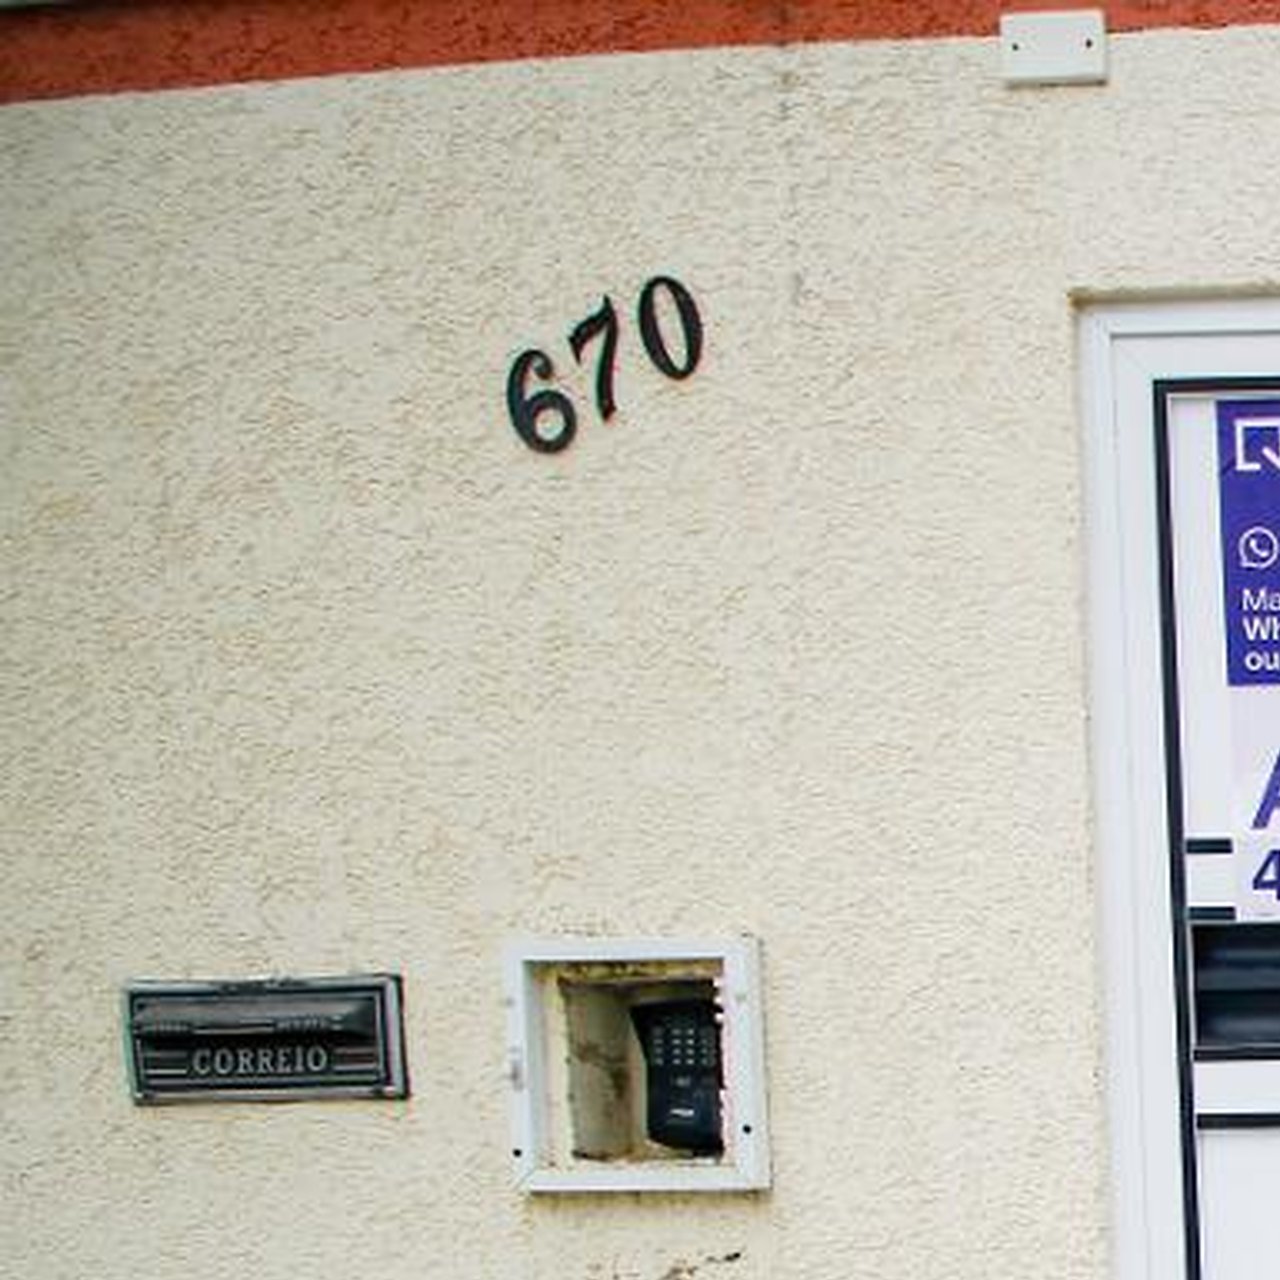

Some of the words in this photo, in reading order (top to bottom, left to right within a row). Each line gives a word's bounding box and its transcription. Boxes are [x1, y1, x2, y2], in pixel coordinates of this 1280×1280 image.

[506, 275, 704, 454] 670
[1244, 650, 1280, 671] ou
[192, 1046, 328, 1075] CORREIO
